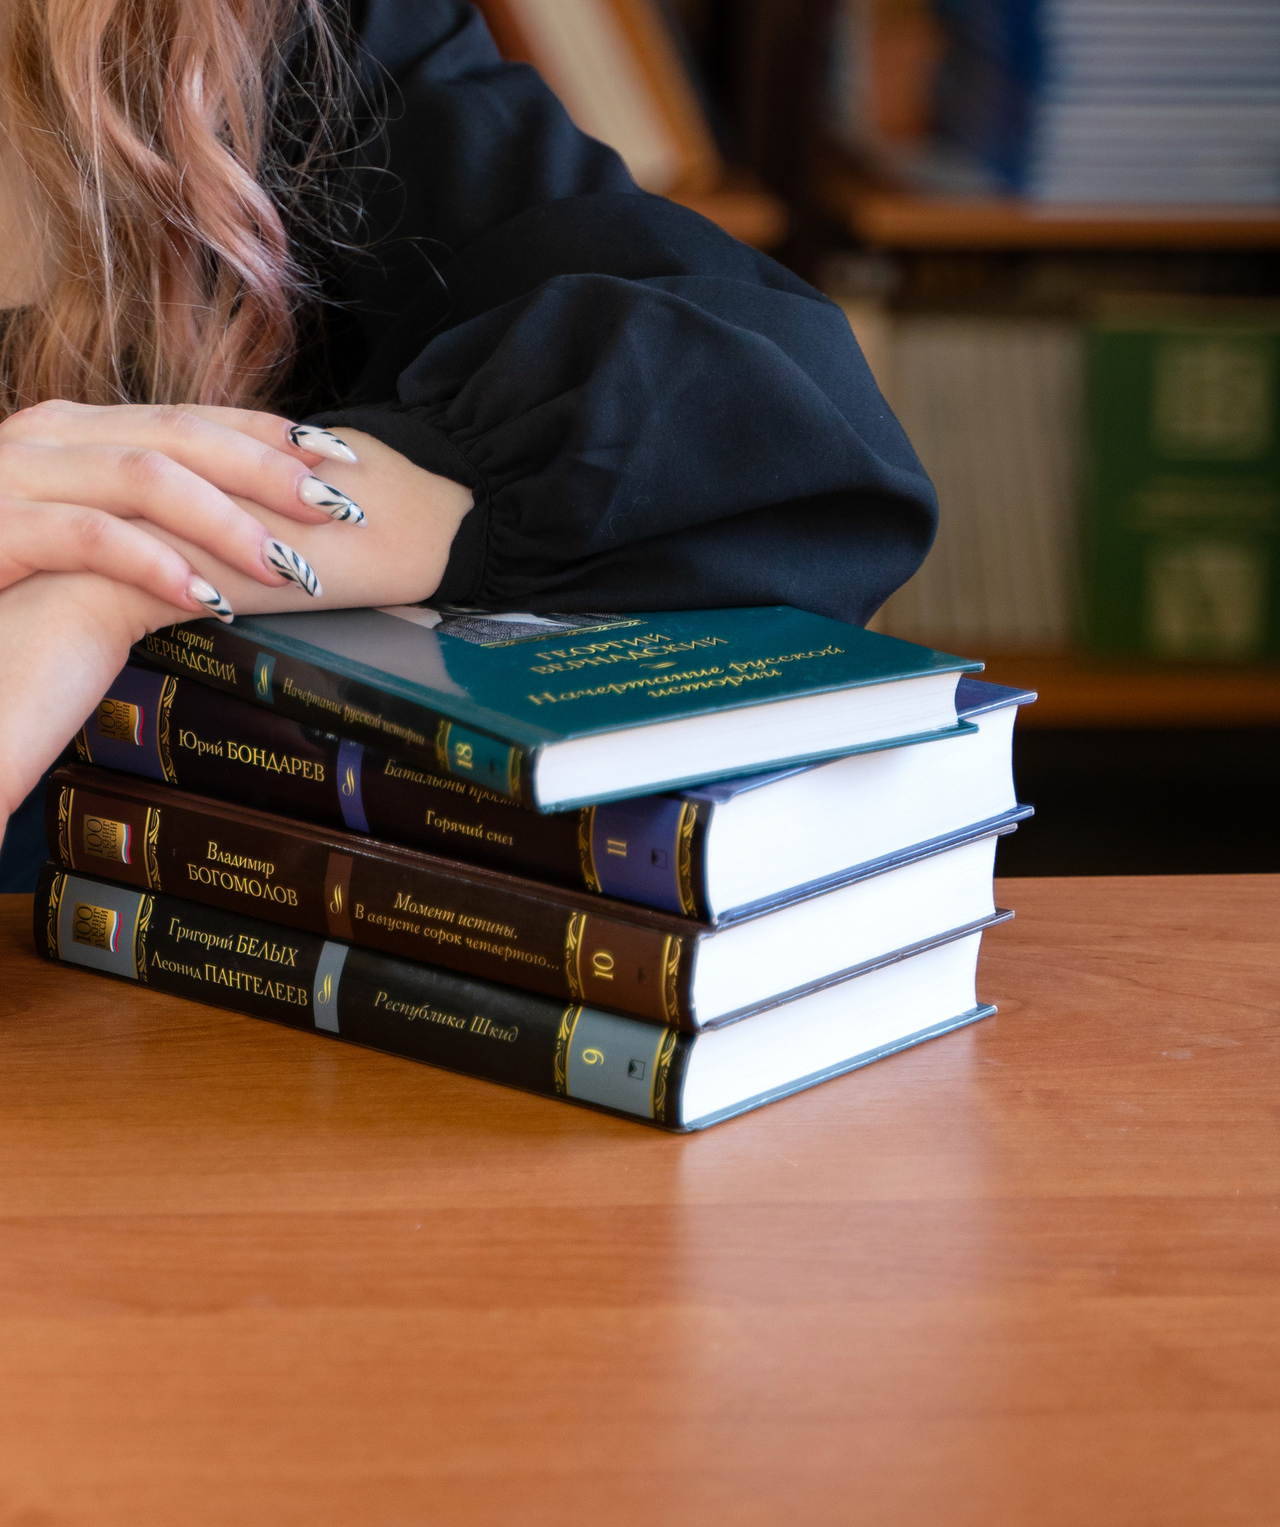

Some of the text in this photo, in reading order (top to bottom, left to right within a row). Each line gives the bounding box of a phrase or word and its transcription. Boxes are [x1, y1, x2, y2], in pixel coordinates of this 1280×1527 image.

[146, 634, 237, 684] ВЕРНАДСКИЙ
[530, 636, 729, 675] ВЕРНАДСКИЙ
[534, 632, 673, 662] ГЕОРГИЙ
[527, 644, 847, 707] Начертание русской
[647, 668, 783, 699] истории
[100, 700, 116, 735] 100
[283, 677, 426, 746] Начертание русской истории
[178, 728, 326, 782] Юрий БОНДАРЕВ
[455, 742, 474, 770] 18
[384, 759, 467, 794] Батальоны
[86, 818, 104, 856] 100
[107, 821, 118, 861] РОССИИ
[426, 810, 515, 847] Горячий снег
[606, 838, 628, 858] 11
[206, 840, 275, 879] Владимир
[187, 863, 299, 907] БОГОМОЛОВ
[75, 905, 93, 943] 100
[96, 909, 109, 949] РОССИИ
[355, 903, 366, 920] В
[367, 910, 422, 936] августе
[423, 925, 463, 947] сорок
[393, 891, 519, 941] Момент истины.
[169, 917, 300, 967] Григорий БЕЛЫХ
[151, 950, 309, 1007] Леонид ПАНТЕЛЕЕВ
[592, 951, 615, 981] 10
[373, 990, 520, 1043] Республика Шкид
[582, 1048, 606, 1067] 9
